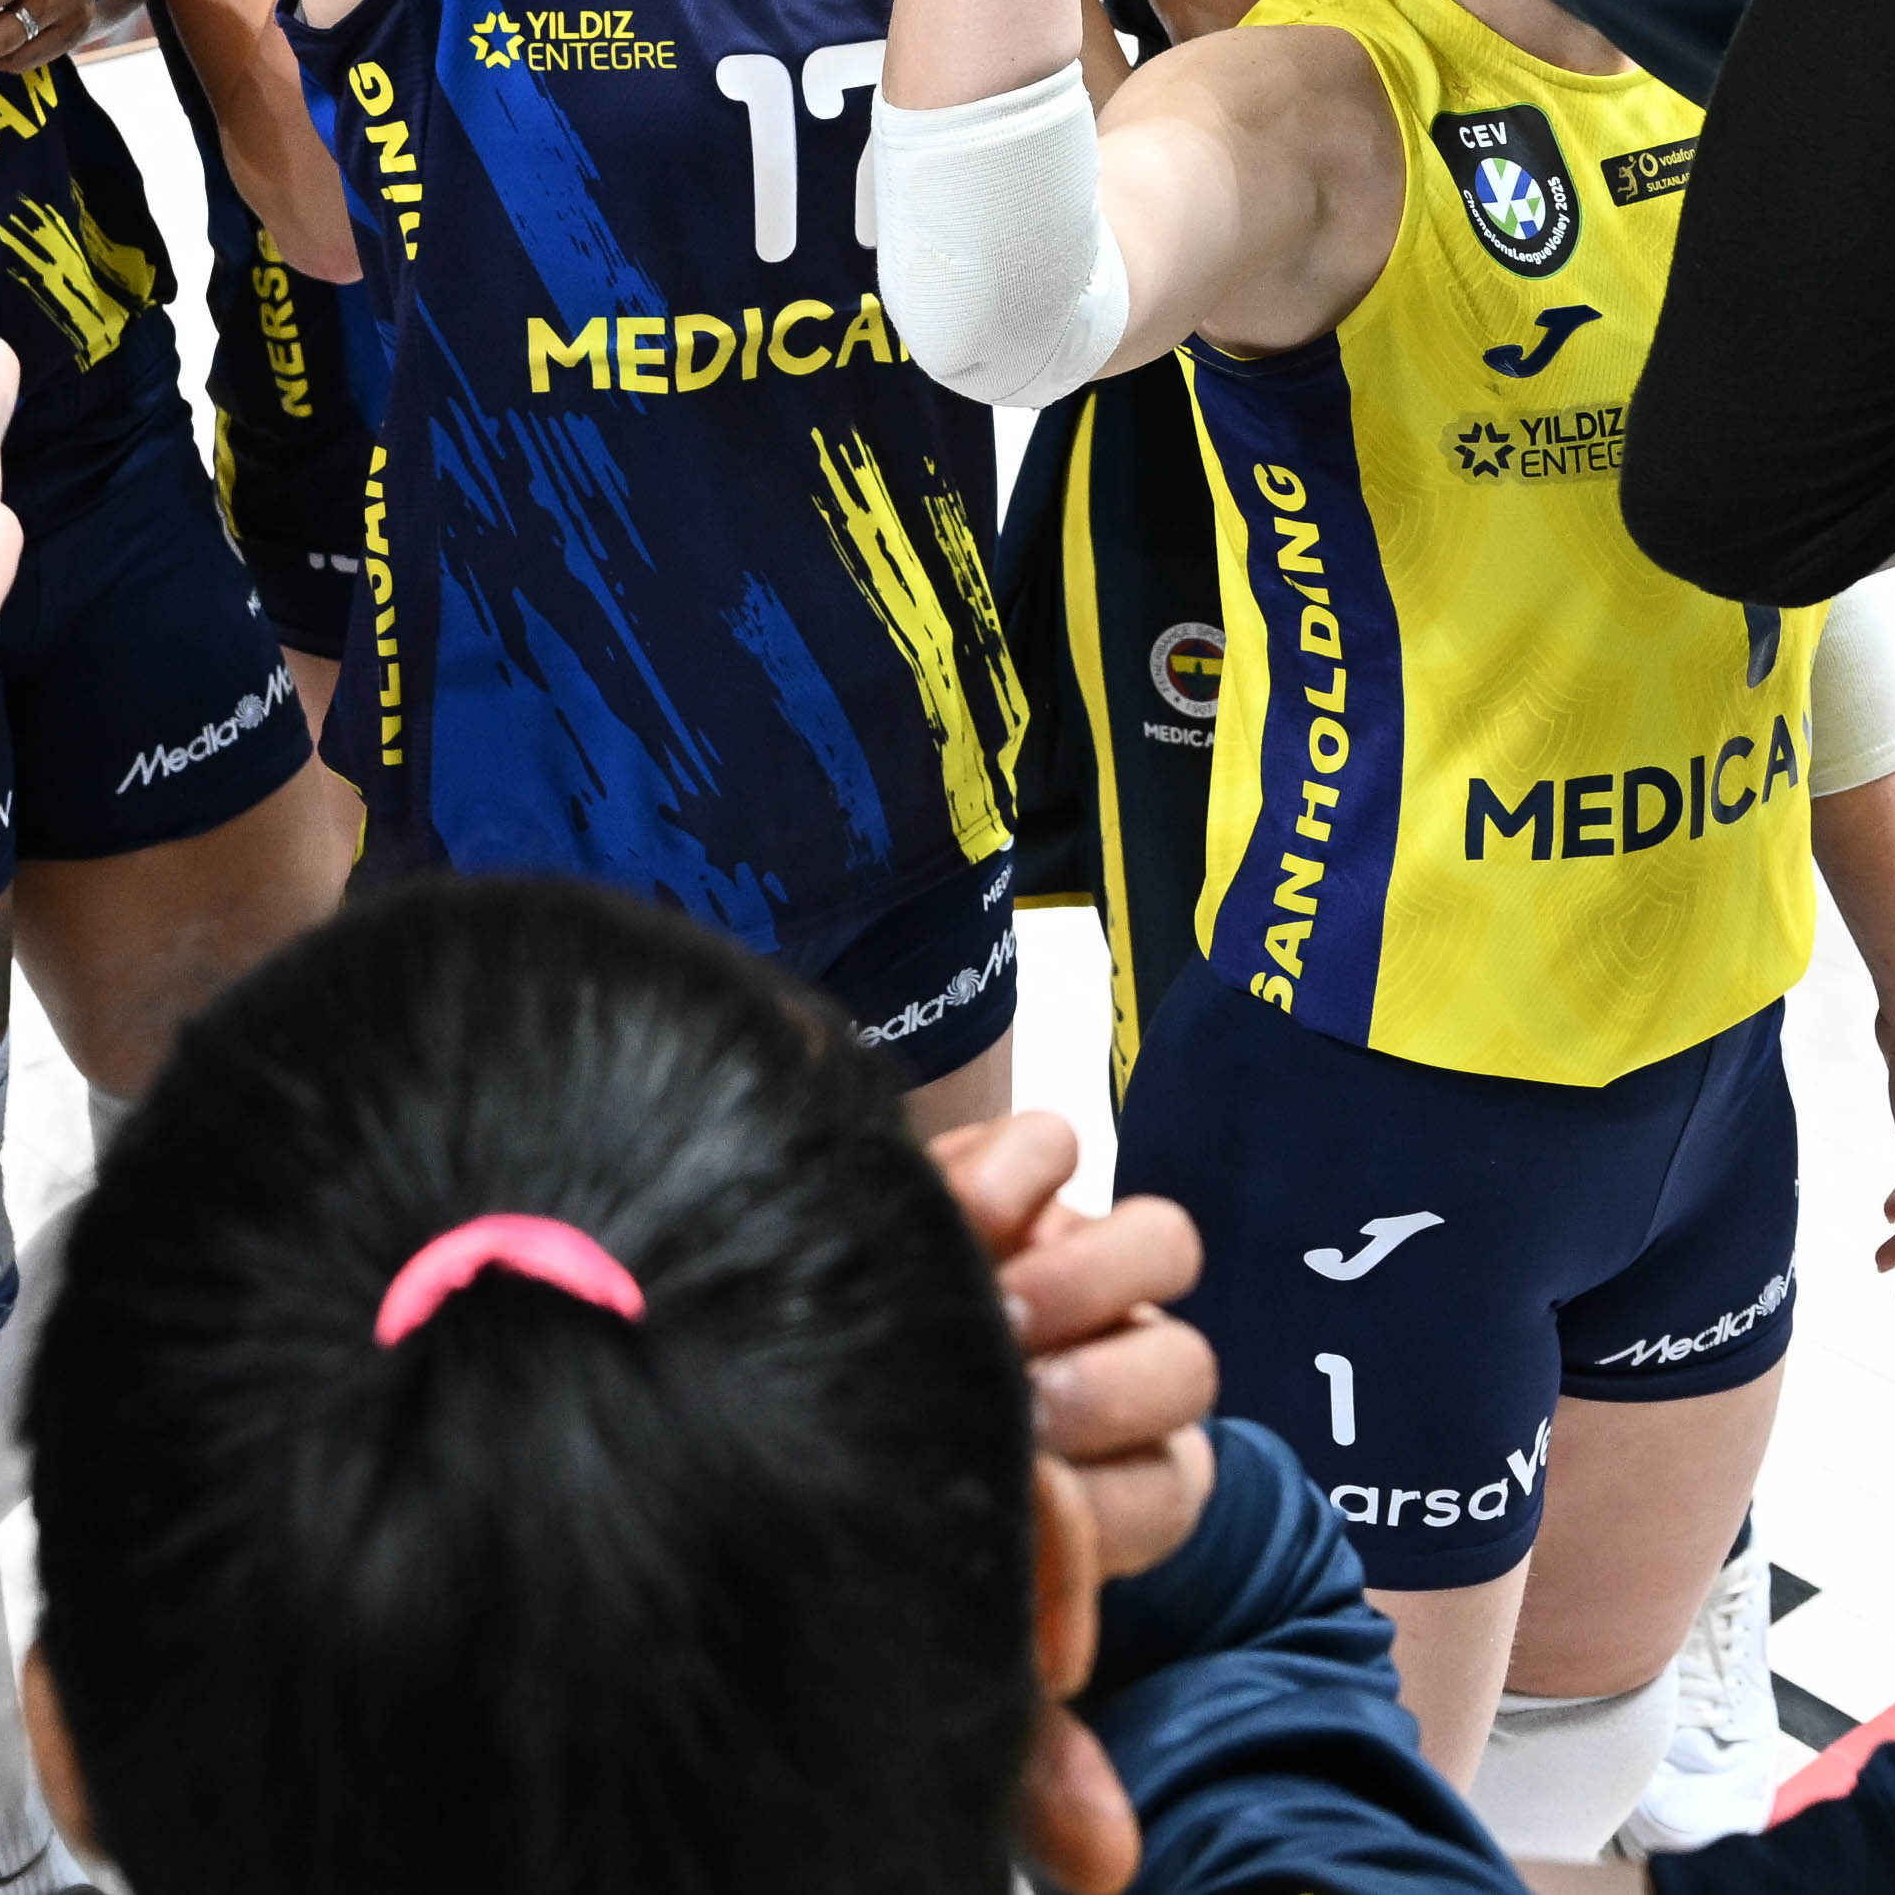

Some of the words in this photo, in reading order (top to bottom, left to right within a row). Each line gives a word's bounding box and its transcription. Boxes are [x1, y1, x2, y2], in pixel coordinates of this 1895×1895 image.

[526, 10, 635, 40] YILDIZ
[527, 41, 678, 71] ENTEGRE
[1459, 121, 1507, 149] CEV
[1463, 189, 1571, 265] ChampionsLeagueVolley
[1547, 176, 1568, 211] 2025
[527, 292, 910, 395] MEDICA
[1519, 407, 1625, 446] YILDIZ
[1464, 713, 1813, 861] MEDICA
[1314, 1352, 1356, 1447] 1
